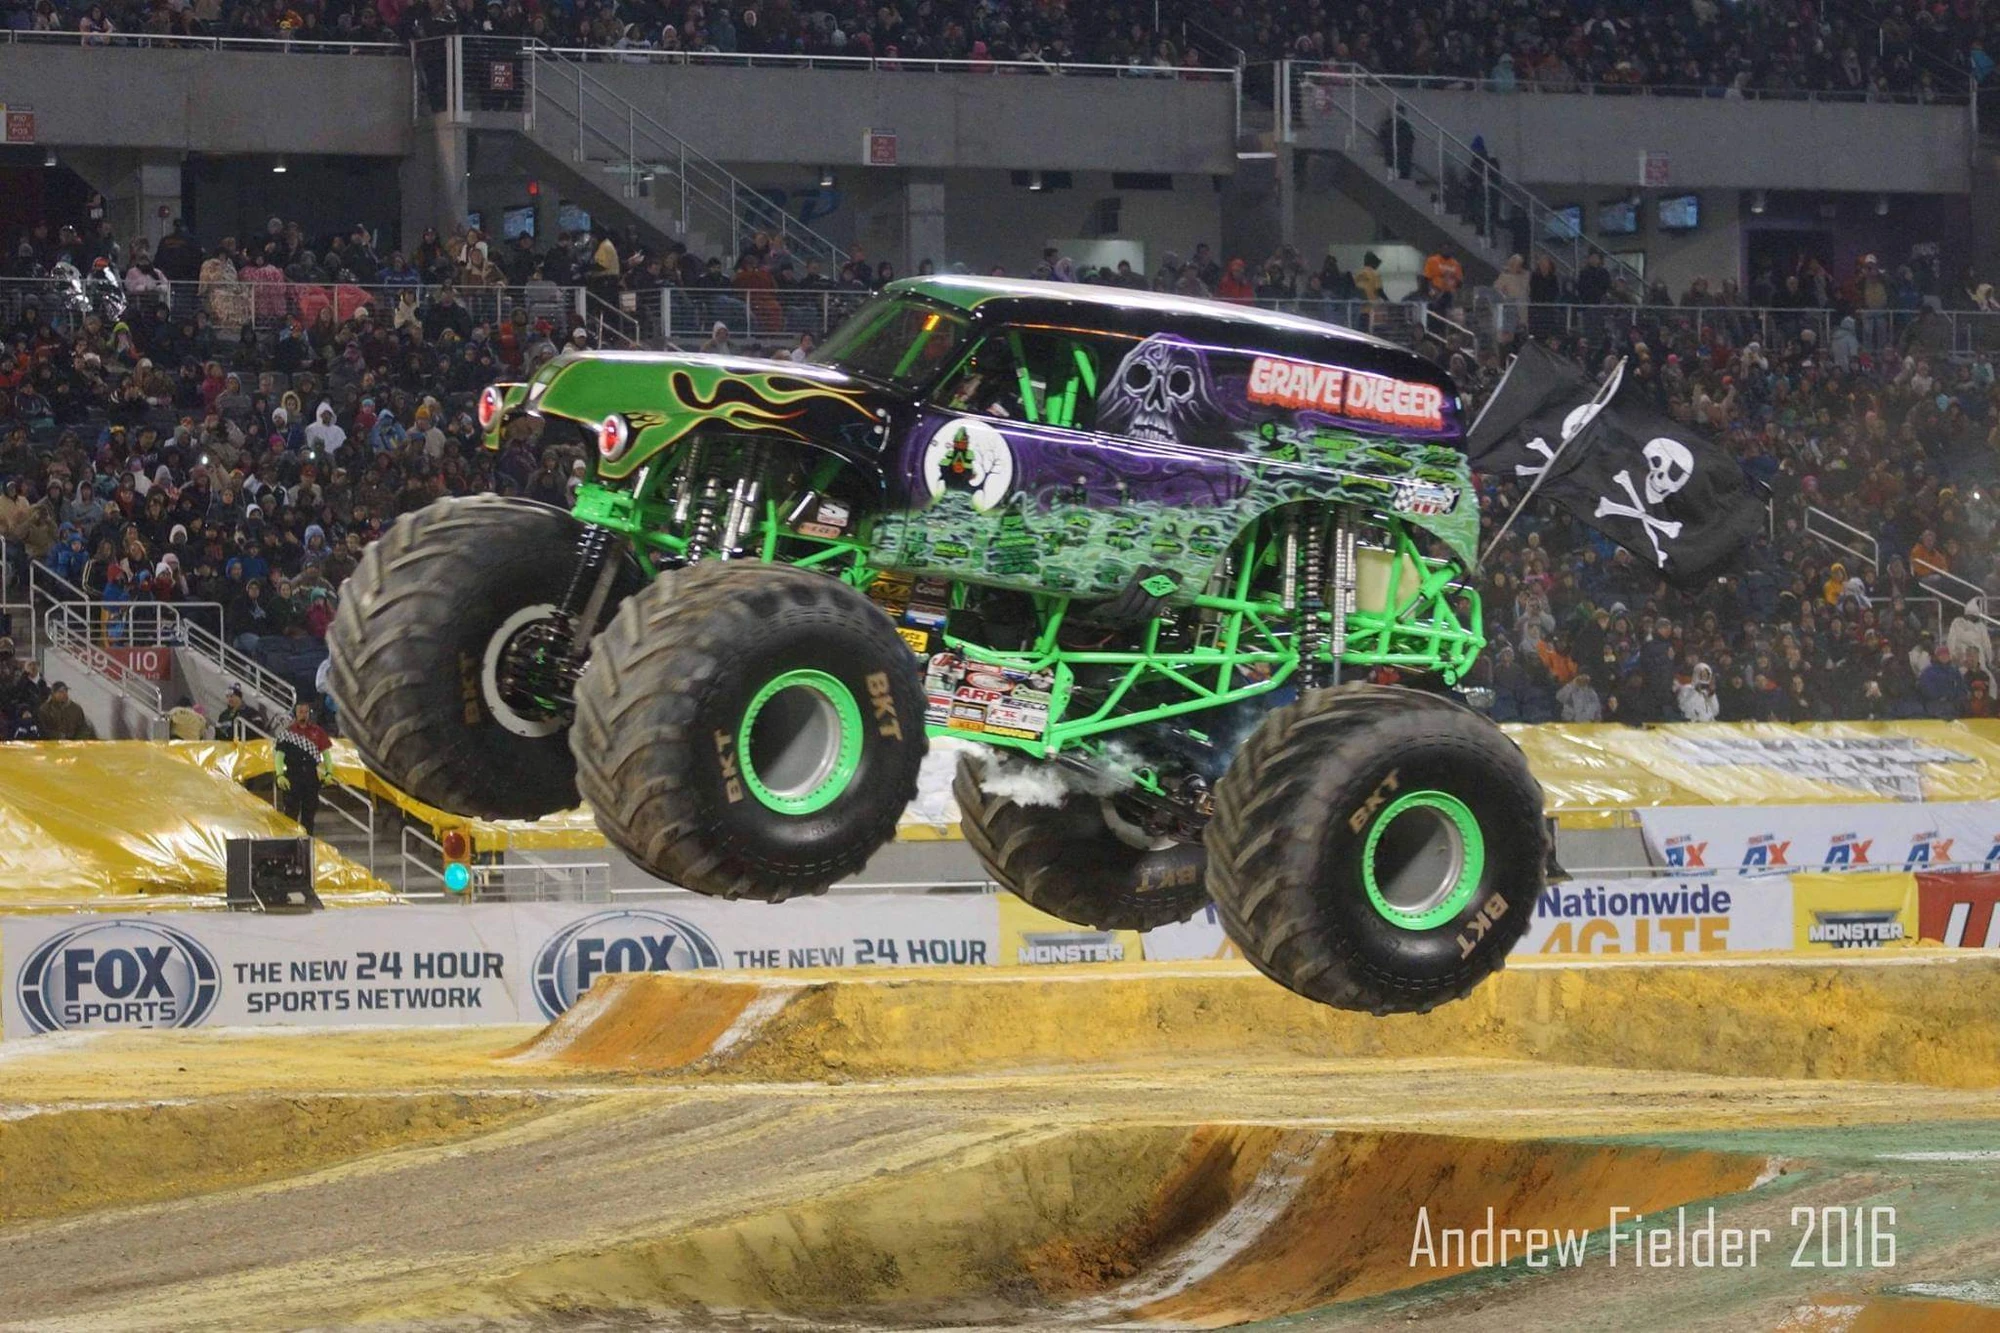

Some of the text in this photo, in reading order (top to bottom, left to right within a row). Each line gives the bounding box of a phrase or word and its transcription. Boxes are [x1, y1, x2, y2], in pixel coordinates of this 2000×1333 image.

[1249, 357, 1442, 424] GRAVE DIGGER
[127, 650, 158, 672] 110
[865, 671, 903, 741] BKT
[956, 687, 1002, 703] ARP
[714, 728, 744, 804] BKT
[1349, 768, 1399, 835] BKT
[1821, 839, 1874, 873] AX
[1903, 838, 1955, 872] AX
[1135, 863, 1197, 893] BKT
[1538, 884, 1732, 918] Nationwide
[1456, 892, 1509, 961] BKT
[1808, 922, 1904, 942] MONSTER
[233, 952, 505, 985] THE NEW 24 HOUR
[576, 934, 677, 990] FOX
[734, 938, 987, 969] THE NEW 24 HOUR
[1018, 944, 1124, 965] MONSTER
[63, 946, 176, 1001] FOX
[64, 1001, 177, 1025] SPORTS
[246, 987, 482, 1014] SPORTS NETWORK
